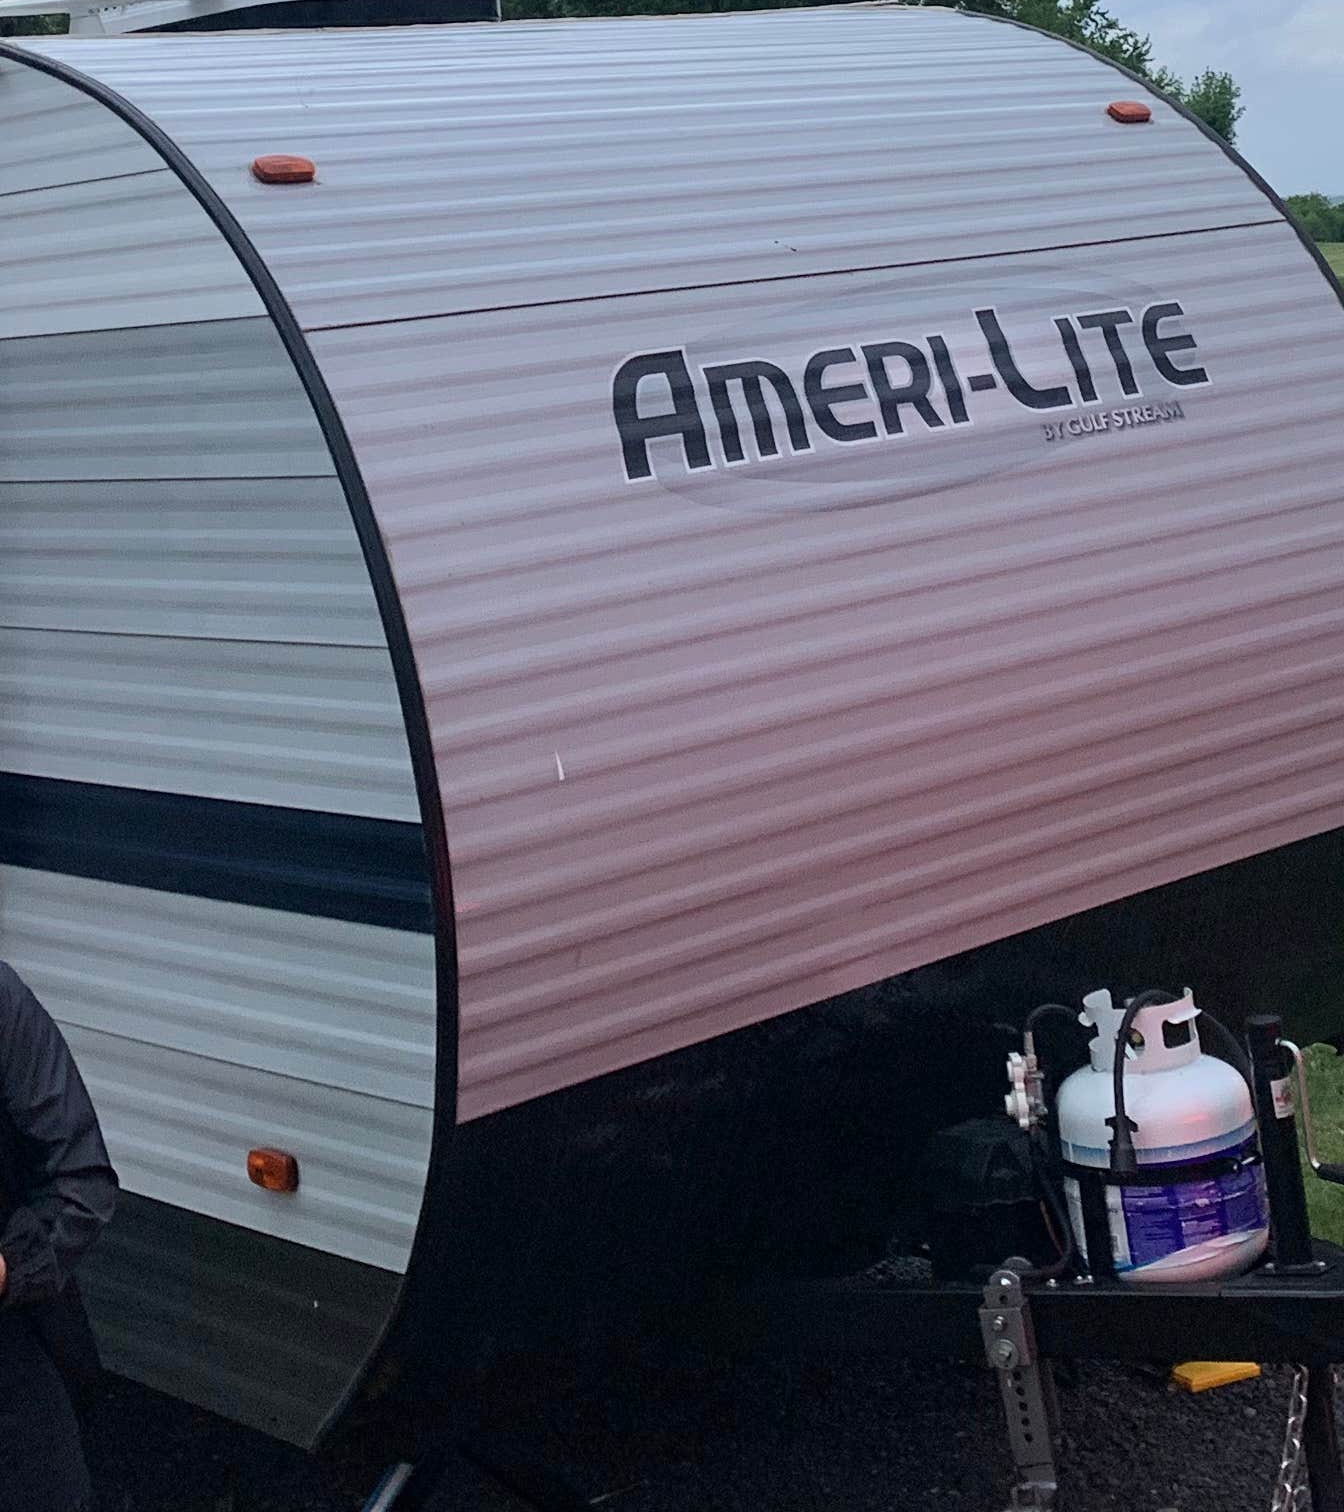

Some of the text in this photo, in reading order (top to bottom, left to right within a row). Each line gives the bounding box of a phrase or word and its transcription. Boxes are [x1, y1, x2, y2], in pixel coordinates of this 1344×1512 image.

[1042, 400, 1186, 441] BY GULF STREAM
